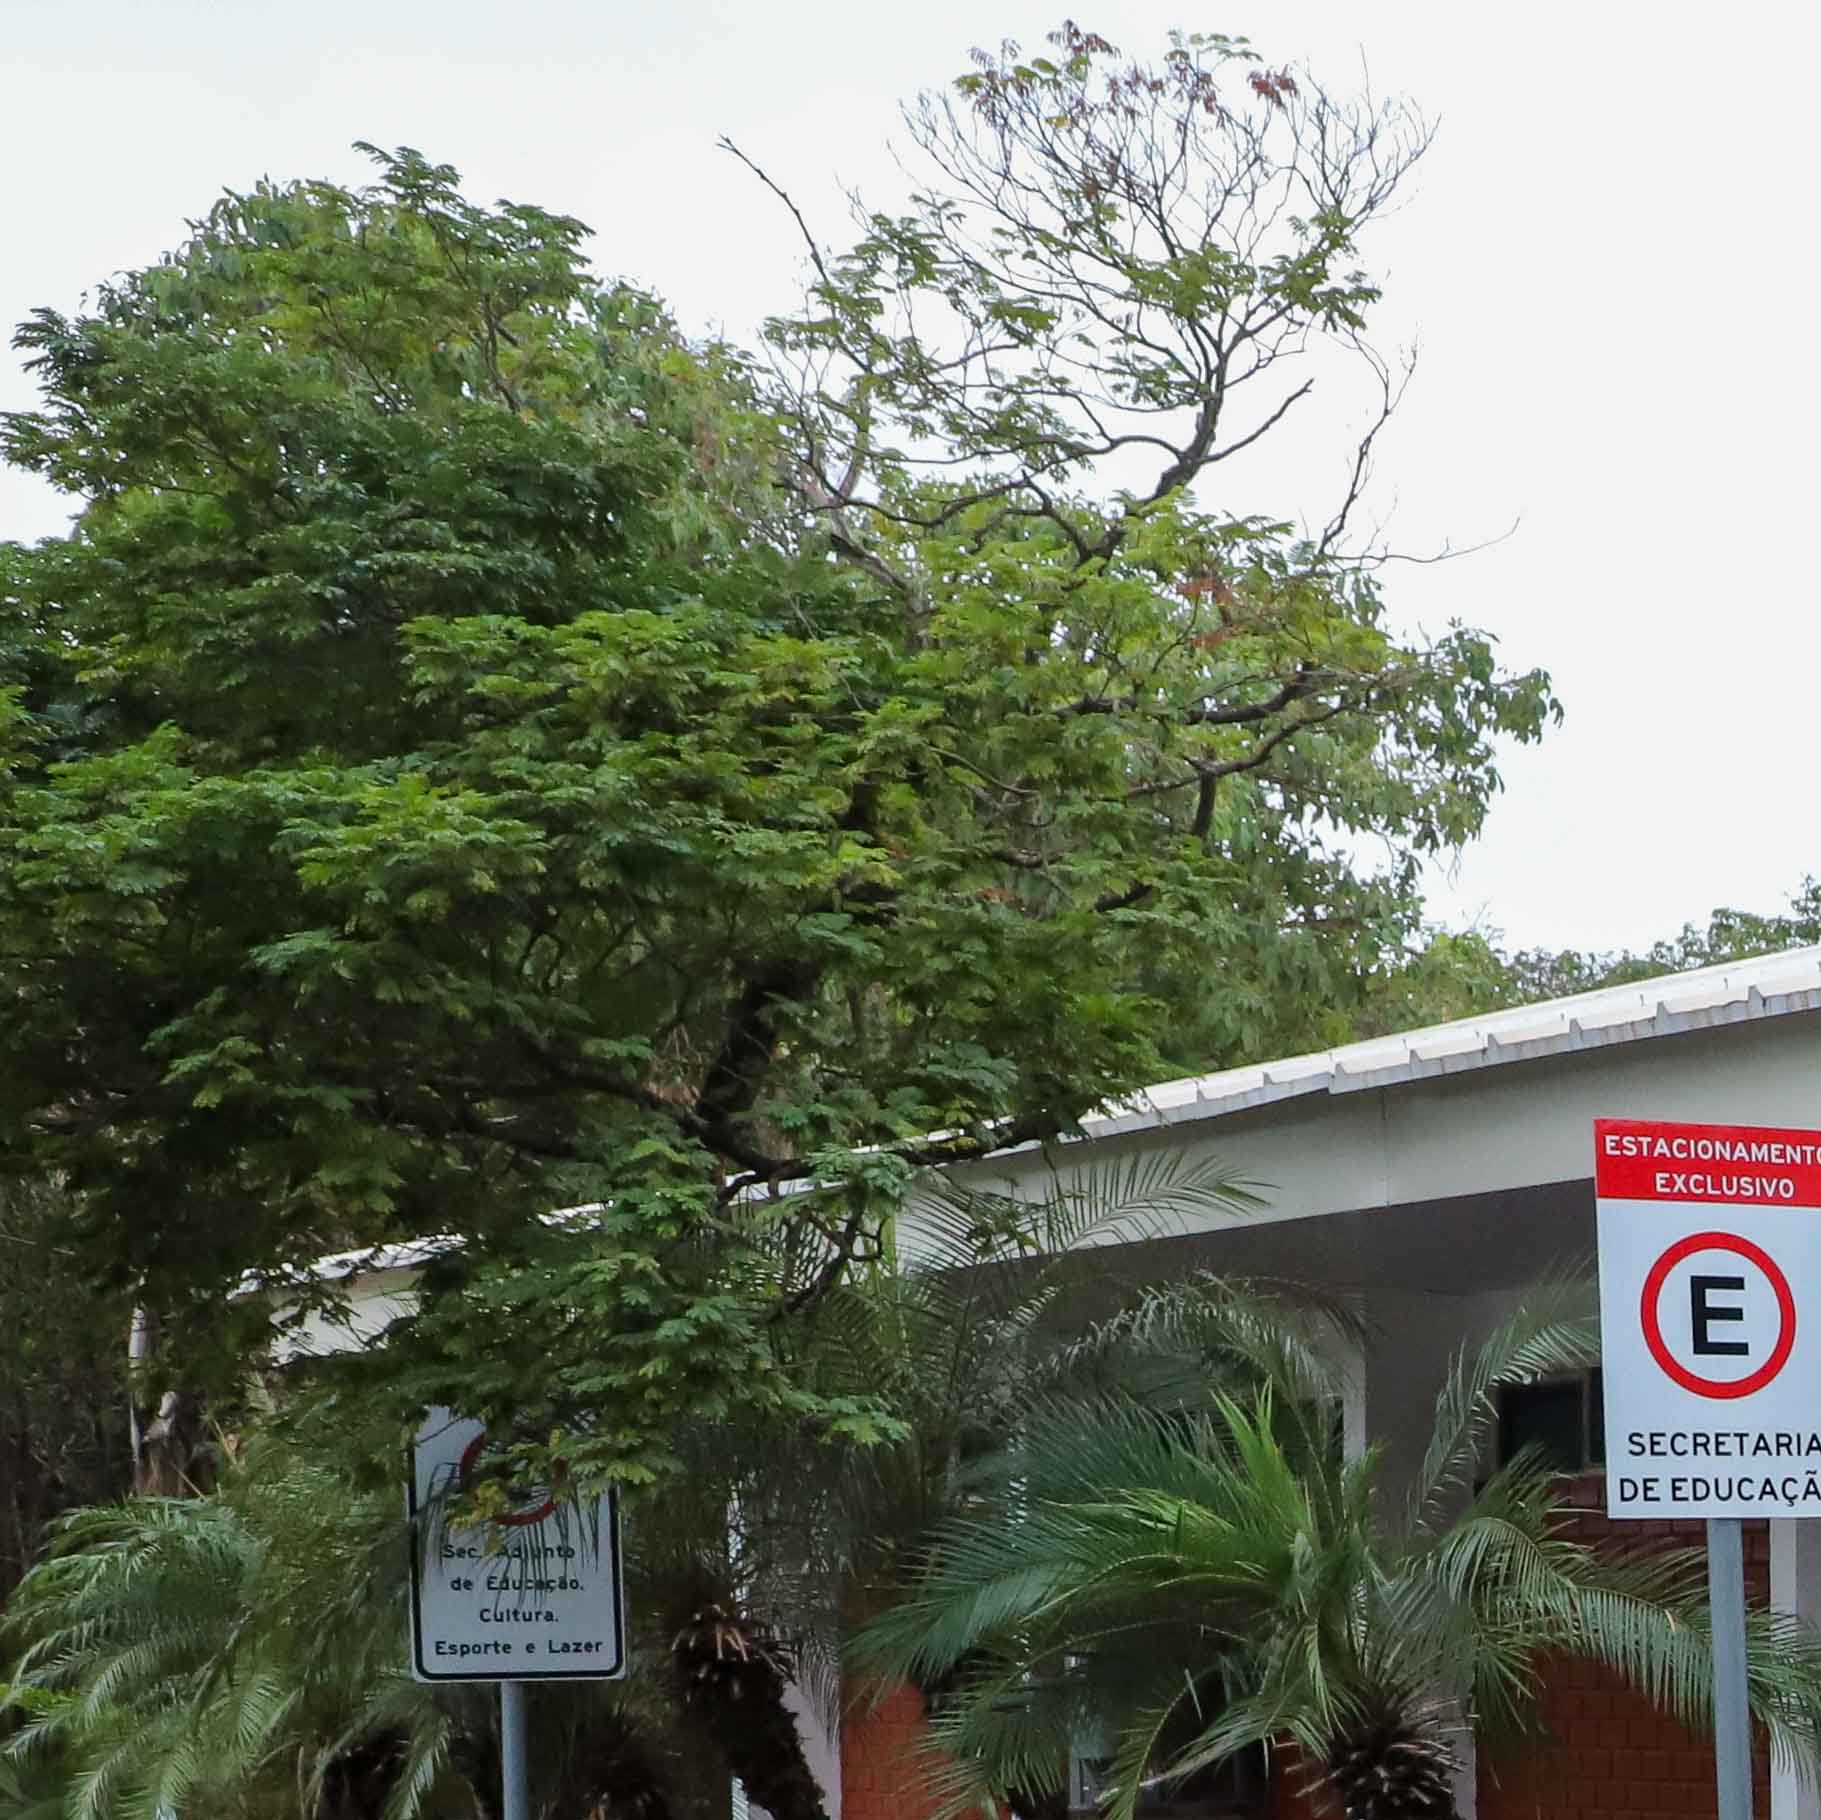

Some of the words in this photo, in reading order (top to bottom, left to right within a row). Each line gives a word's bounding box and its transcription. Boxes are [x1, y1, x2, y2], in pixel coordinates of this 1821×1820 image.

[1655, 1172, 1795, 1198] EXCLUSIVO
[1690, 1275, 1749, 1356] E
[1619, 1478, 1661, 1502] DE
[451, 1577, 473, 1591] de
[435, 1640, 512, 1657] Esporte
[526, 1643, 536, 1653] e
[549, 1639, 603, 1654] Lazer
